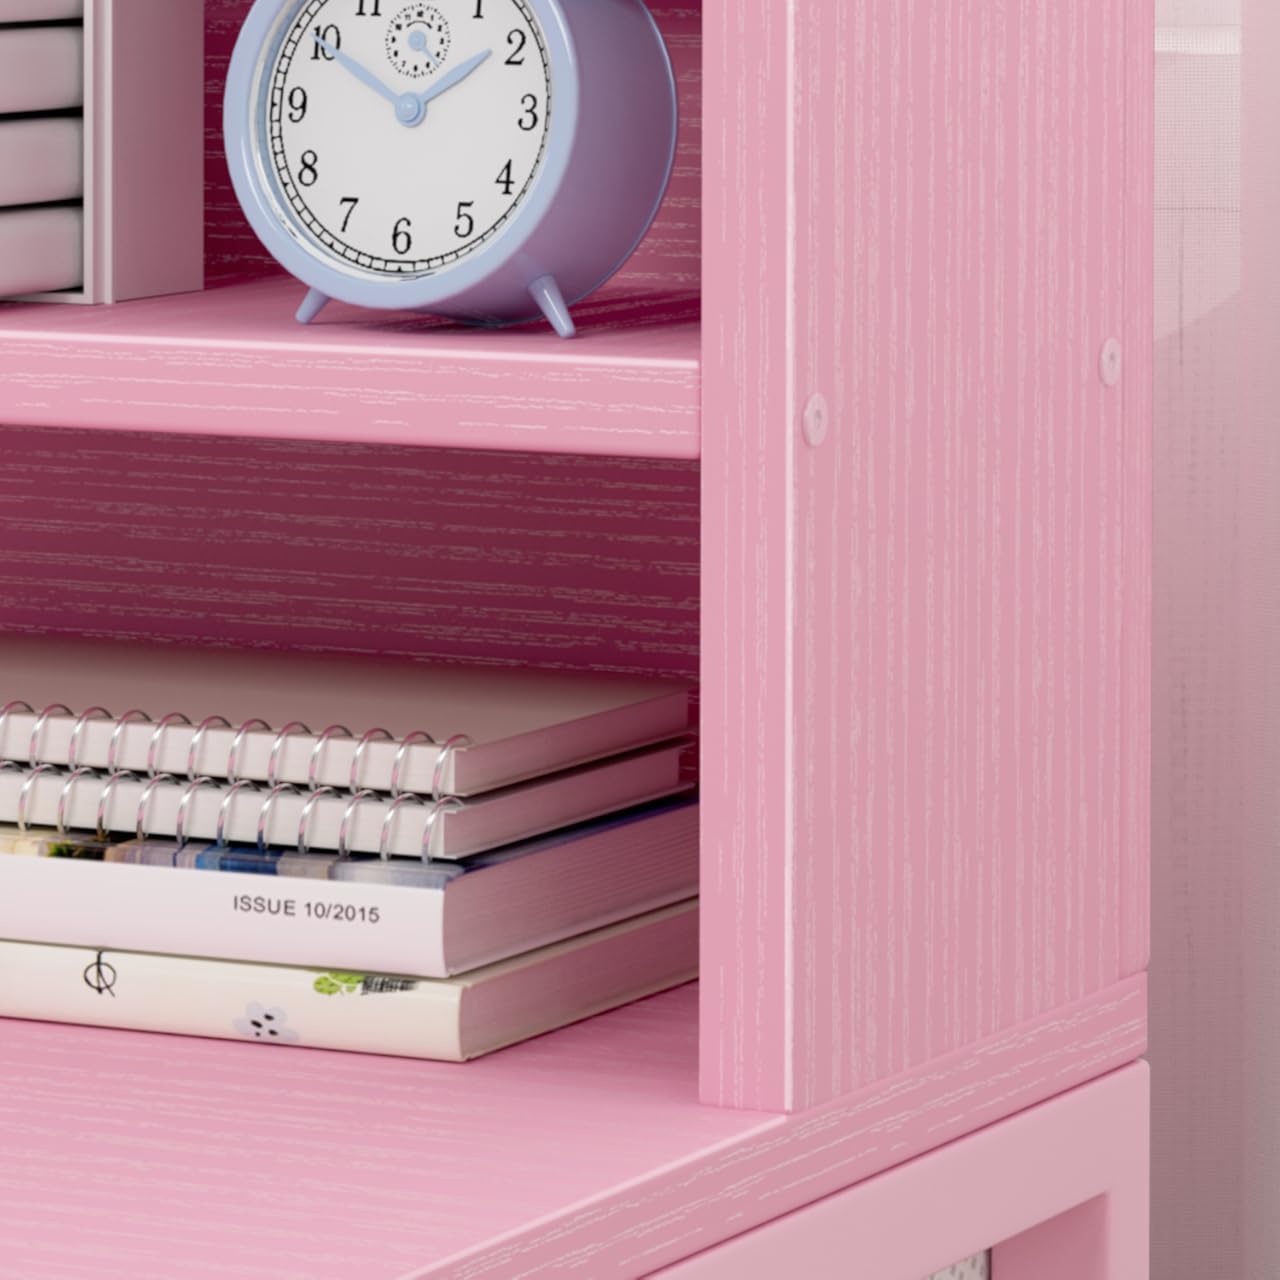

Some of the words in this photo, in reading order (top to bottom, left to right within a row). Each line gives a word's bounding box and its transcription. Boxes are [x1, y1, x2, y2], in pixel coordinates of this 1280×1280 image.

[310, 24, 341, 61] 10
[504, 29, 526, 65] 2
[288, 86, 307, 123] 9
[518, 94, 538, 131] 3
[298, 150, 318, 186] 8
[495, 159, 515, 195] 4
[339, 197, 359, 232] 7
[454, 201, 474, 237] 5
[392, 218, 412, 254] 6
[233, 895, 296, 917] ISSUE
[303, 901, 380, 924] 10/2015
